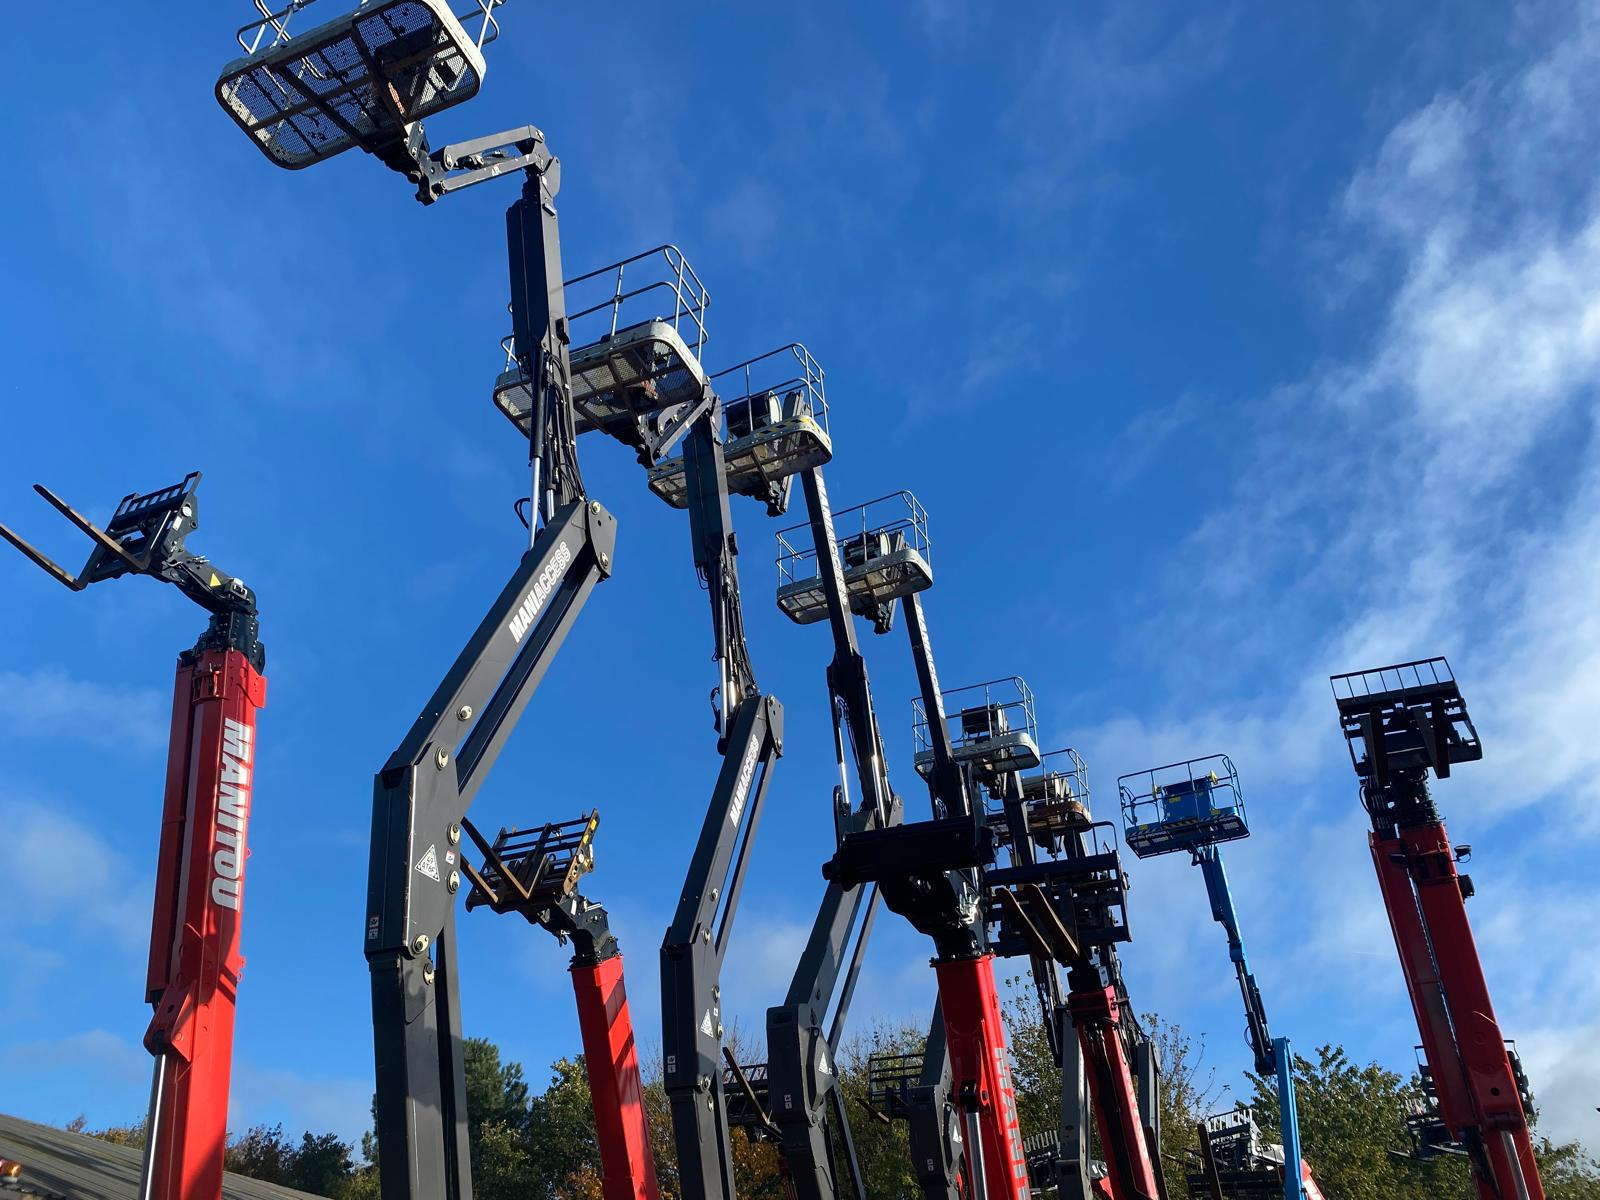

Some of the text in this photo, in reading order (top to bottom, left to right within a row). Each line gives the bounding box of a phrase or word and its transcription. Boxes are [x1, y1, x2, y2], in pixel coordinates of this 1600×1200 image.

[508, 541, 571, 643] MANIACCESS
[211, 717, 252, 912] MANITOU
[729, 733, 759, 828] MANIACCESS
